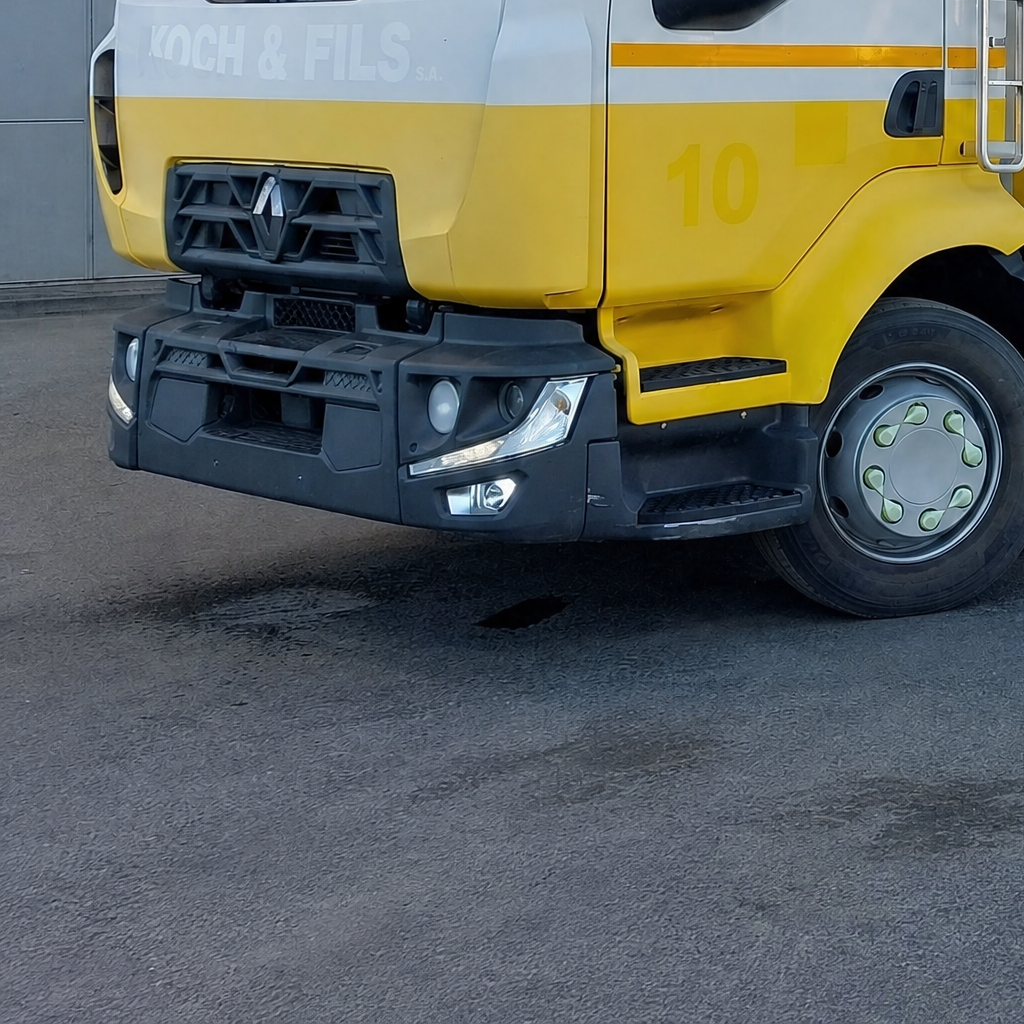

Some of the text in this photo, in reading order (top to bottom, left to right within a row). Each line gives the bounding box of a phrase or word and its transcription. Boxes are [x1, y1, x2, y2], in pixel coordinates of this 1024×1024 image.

[147, 21, 444, 83] KOCH & FILS S.A.
[666, 142, 759, 227] 10
